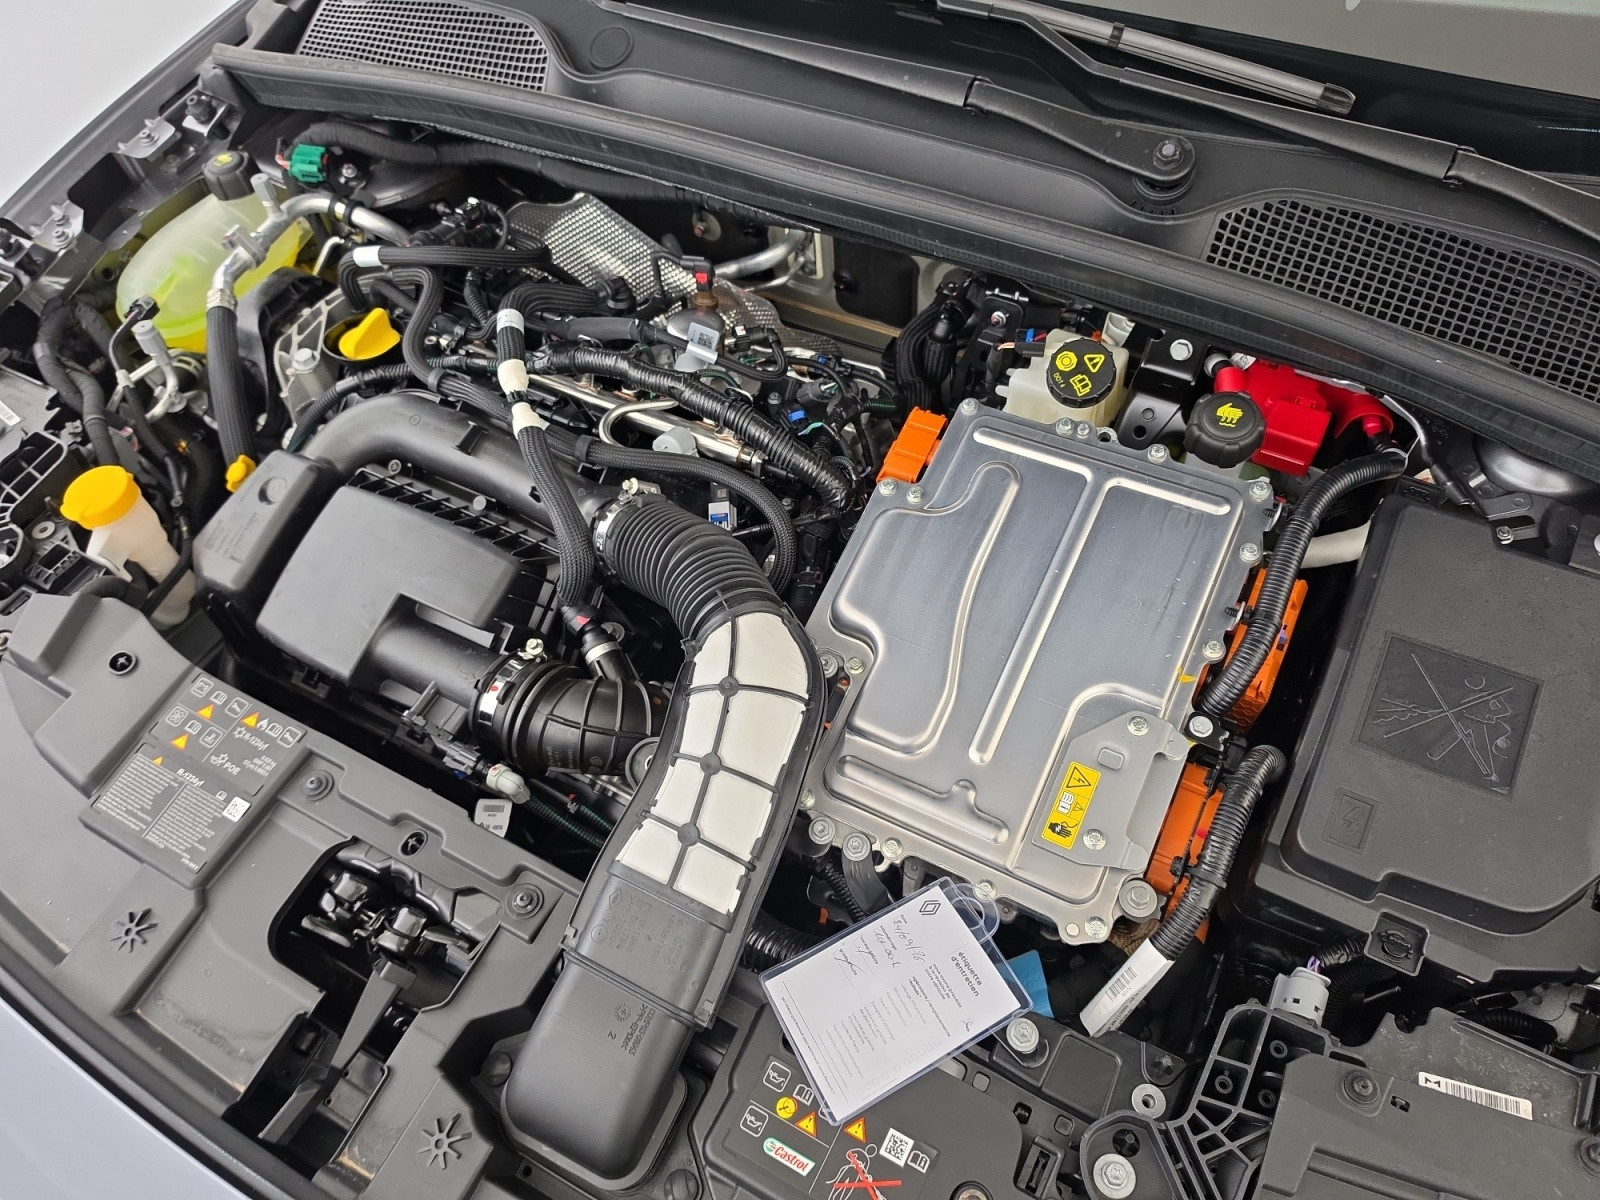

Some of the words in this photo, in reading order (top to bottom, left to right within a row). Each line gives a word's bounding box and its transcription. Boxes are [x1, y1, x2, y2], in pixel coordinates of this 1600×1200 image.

[224, 762, 240, 775] POE
[951, 956, 979, 997] d'entretien
[958, 952, 982, 986] étiquette
[774, 1145, 808, 1171] Castrol
